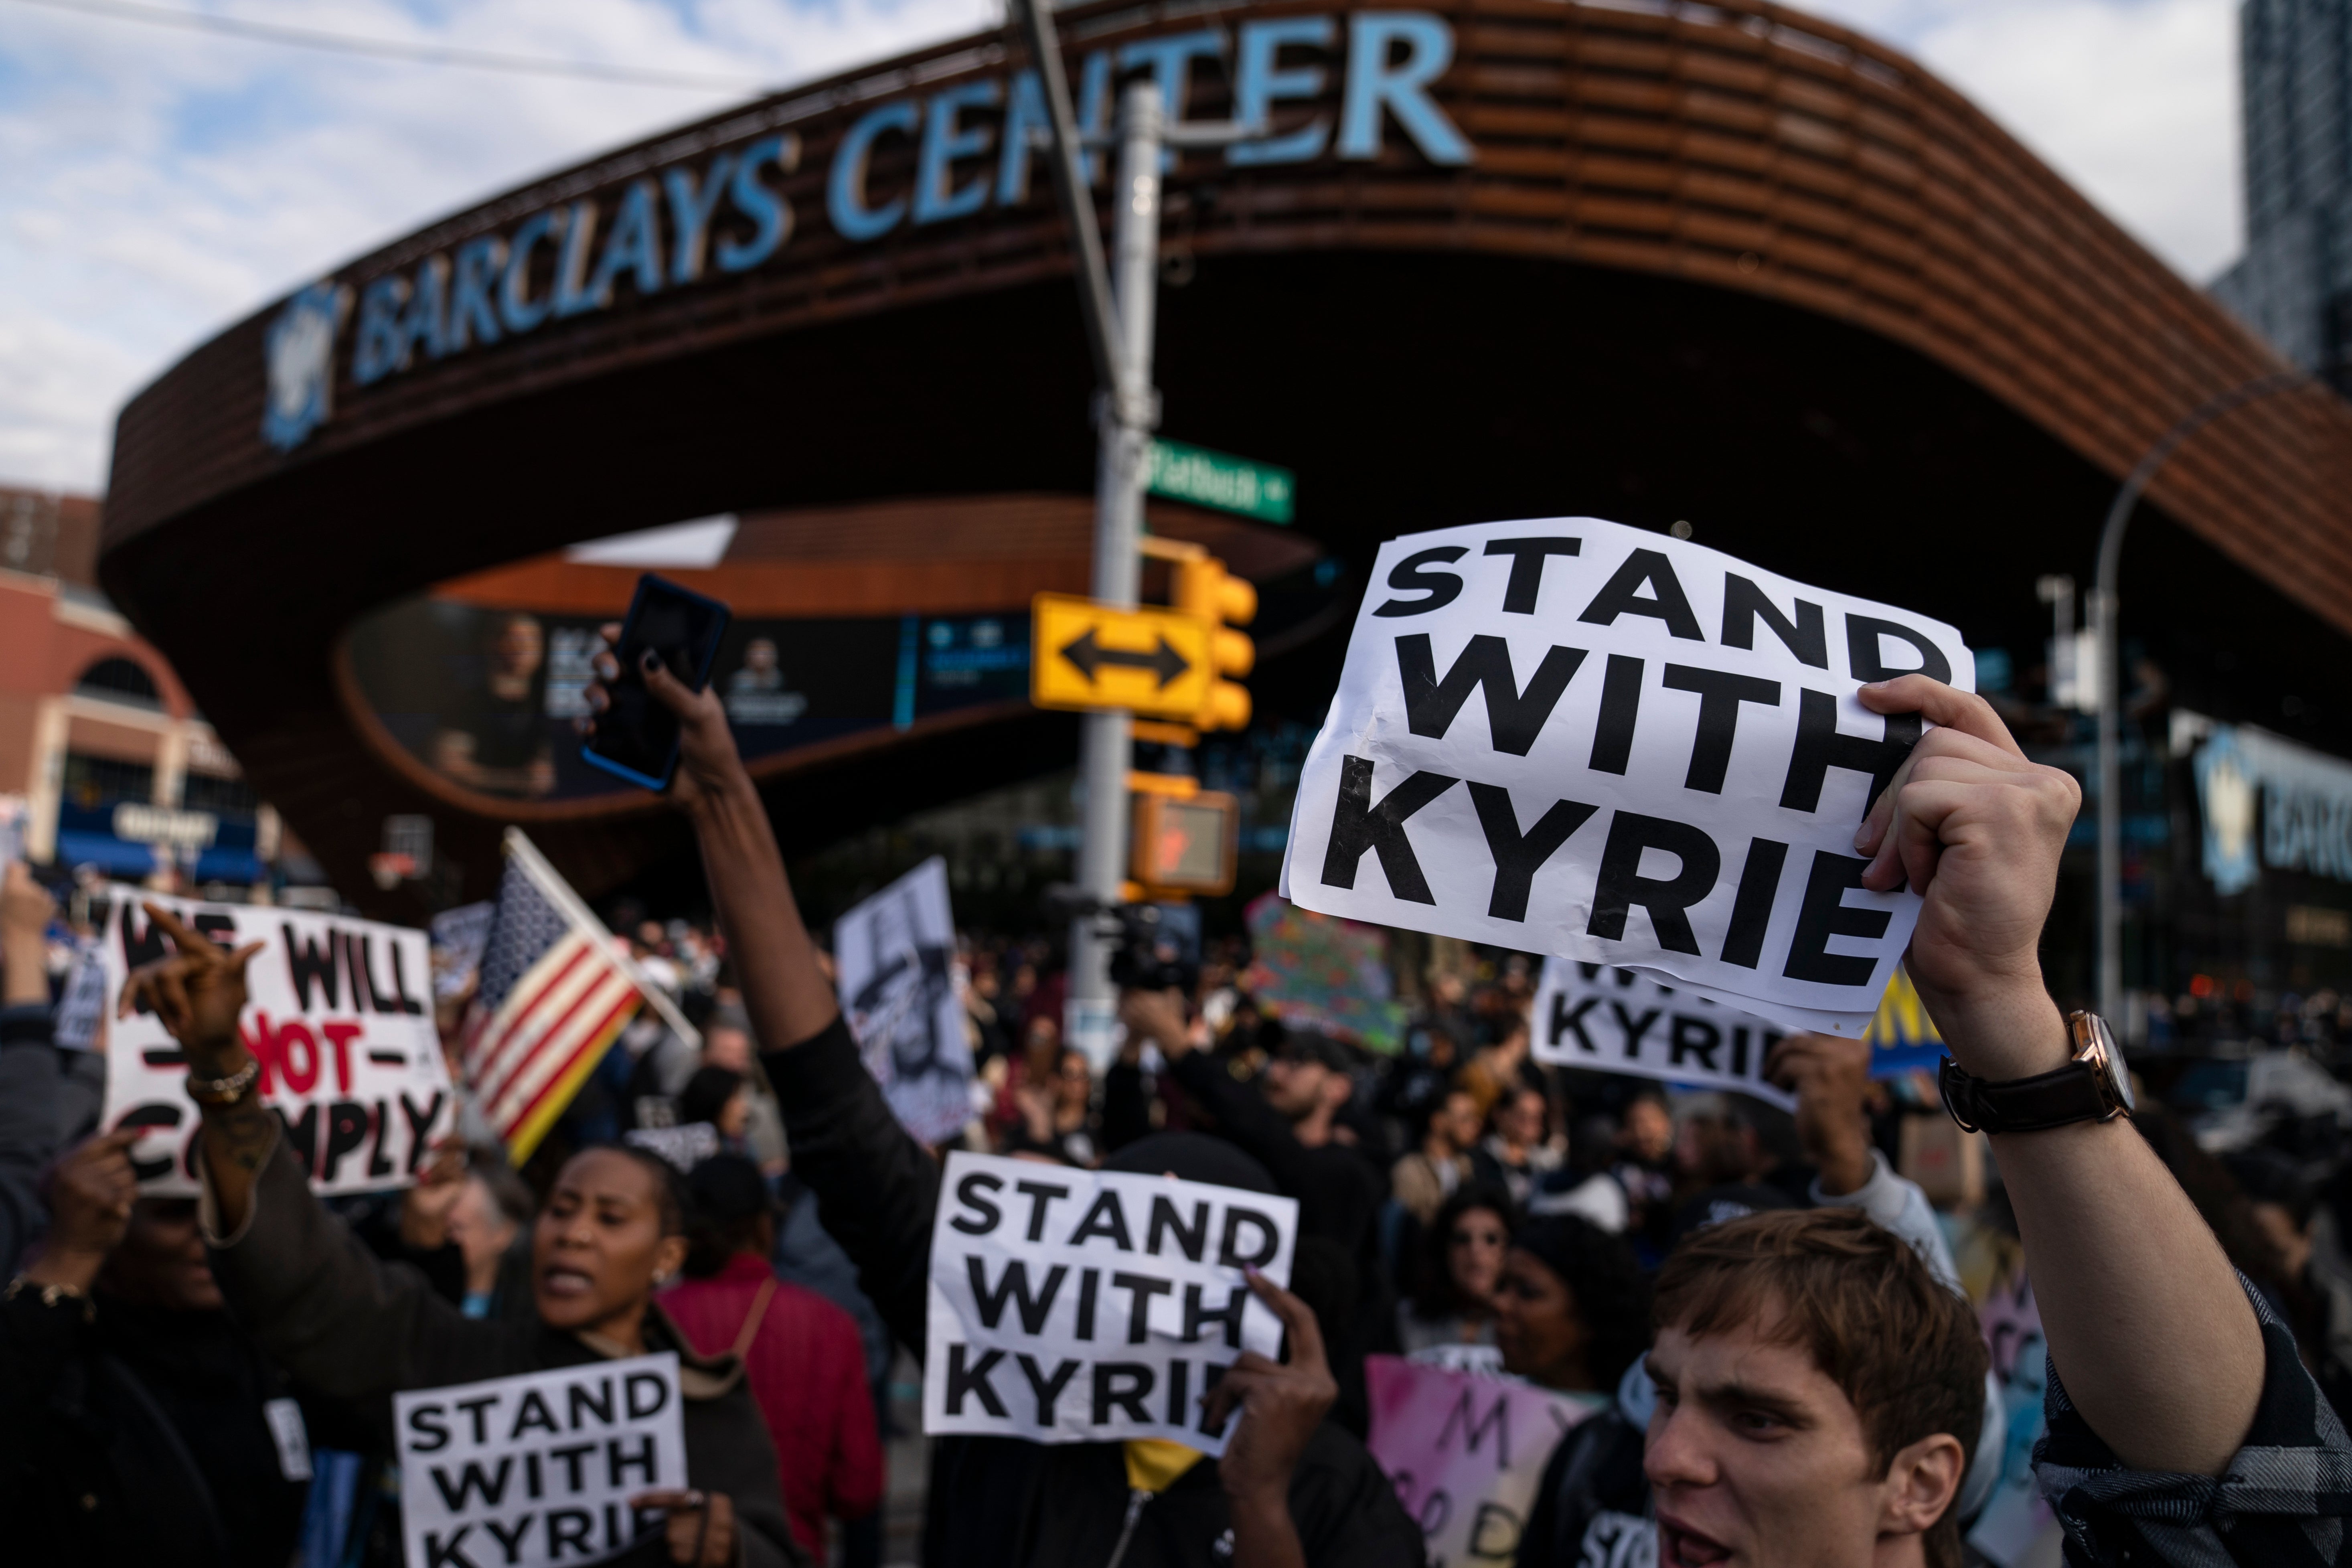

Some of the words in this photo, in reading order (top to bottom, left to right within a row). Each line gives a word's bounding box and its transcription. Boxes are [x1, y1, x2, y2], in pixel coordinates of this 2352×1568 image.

[350, 128, 801, 387] BARCLAYS
[825, 10, 1477, 243] CENTER
[1371, 536, 1952, 685] STAND
[1394, 633, 1923, 823] WITH
[1320, 754, 1906, 987] KYRIE
[282, 921, 421, 1015] WILL
[114, 1089, 444, 1183] CMPLY
[950, 1171, 1280, 1270] STAND
[966, 1254, 1252, 1349] WITH
[409, 1370, 671, 1453] STAND
[430, 1434, 658, 1513] WITH
